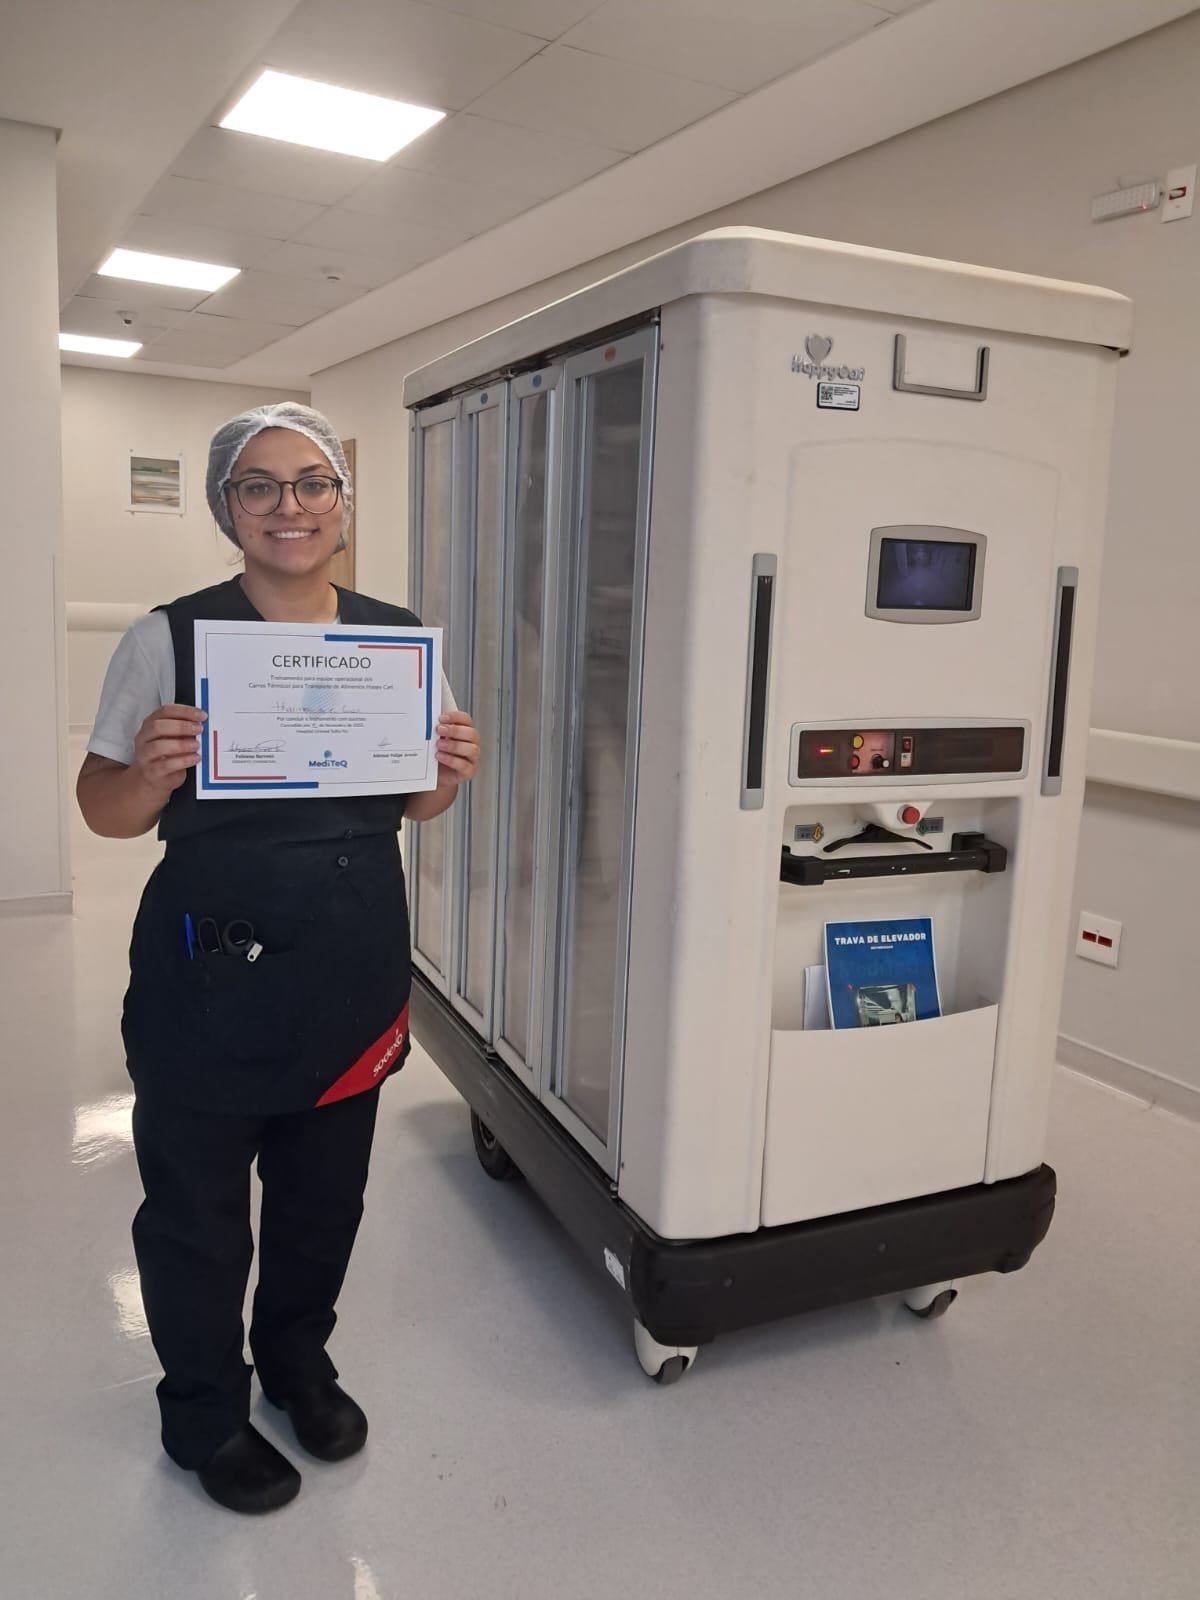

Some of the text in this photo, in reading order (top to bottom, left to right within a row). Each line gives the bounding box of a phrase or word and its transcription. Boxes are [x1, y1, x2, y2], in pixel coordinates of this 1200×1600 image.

[272, 655, 372, 669] CERTIFICADO
[308, 759, 348, 769] MediTeQ
[834, 932, 927, 945] TRAVA DE ELEVADOR
